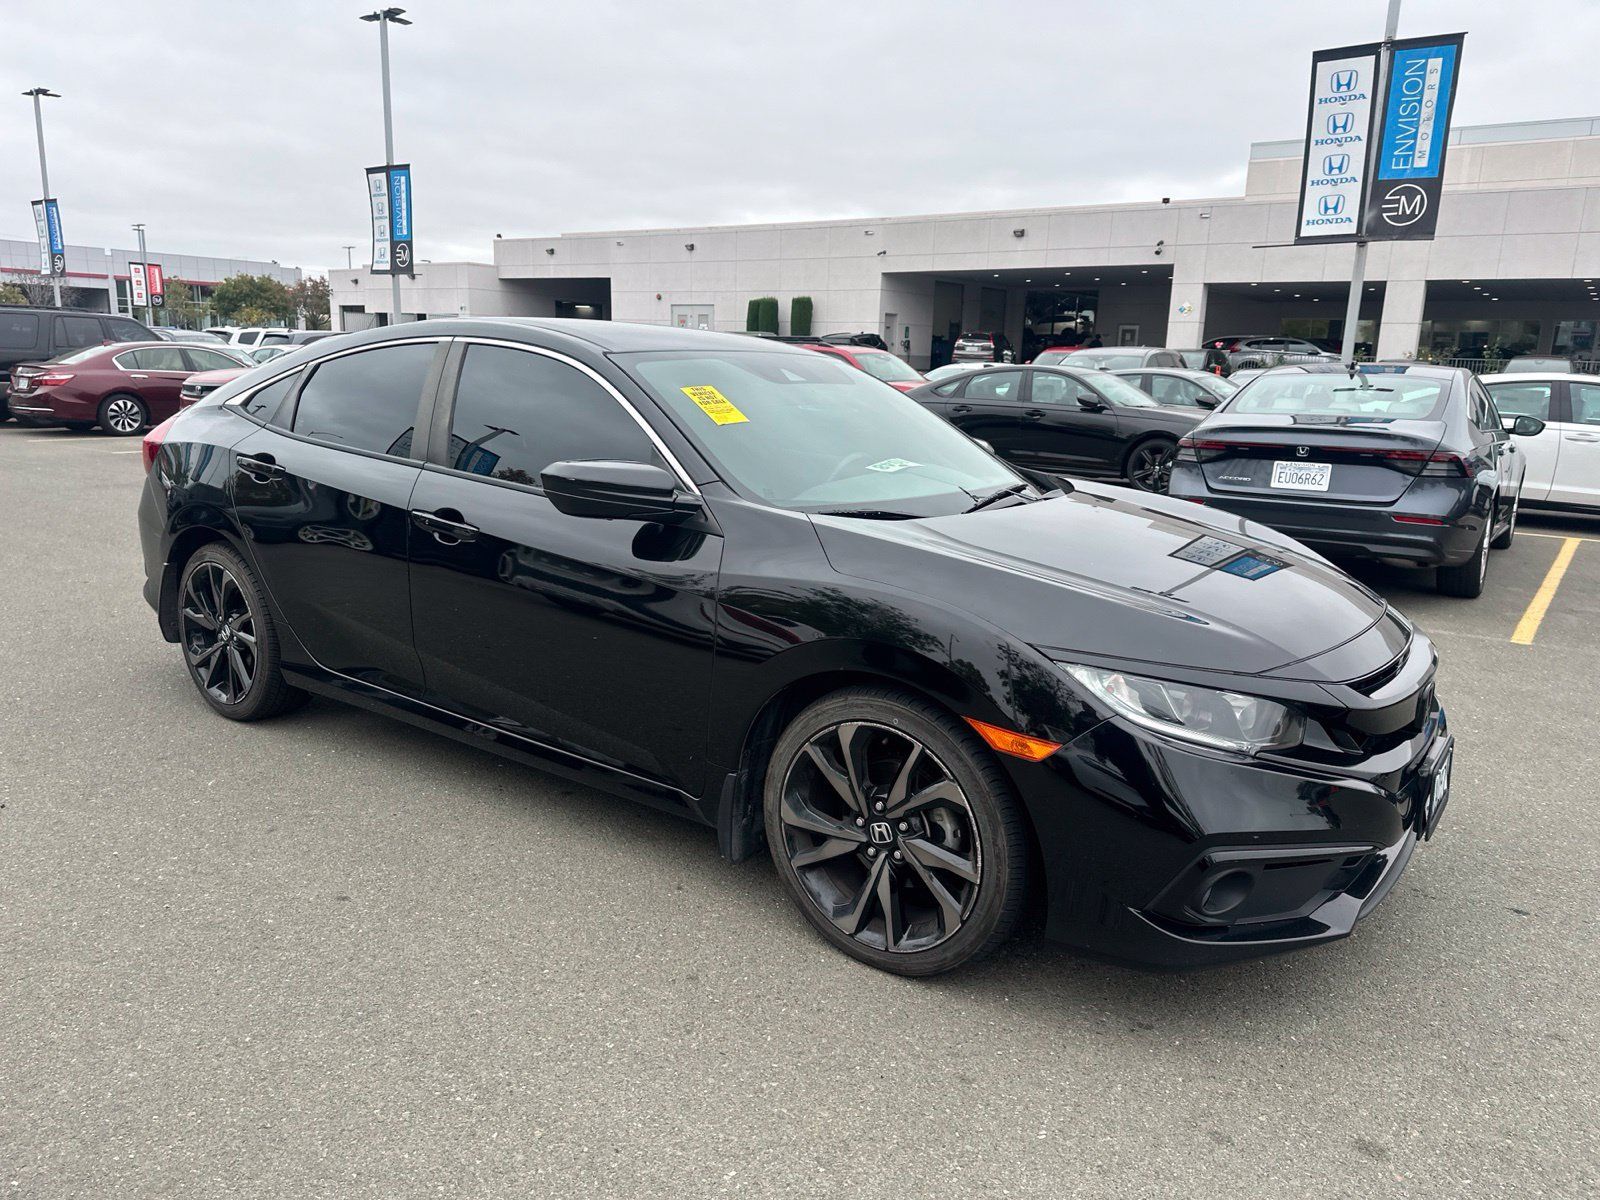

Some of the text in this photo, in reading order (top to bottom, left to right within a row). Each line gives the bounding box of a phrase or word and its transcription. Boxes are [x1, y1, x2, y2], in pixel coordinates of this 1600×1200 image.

[1317, 93, 1368, 105] HONDA
[1392, 58, 1426, 170] ENVISION
[1417, 67, 1439, 159] MOTORS
[1314, 135, 1364, 146] HONDA
[1309, 176, 1359, 187] HONDA
[394, 176, 403, 236] ENVISION
[1305, 216, 1354, 227] HONDA
[1277, 471, 1325, 486] EU06R62
